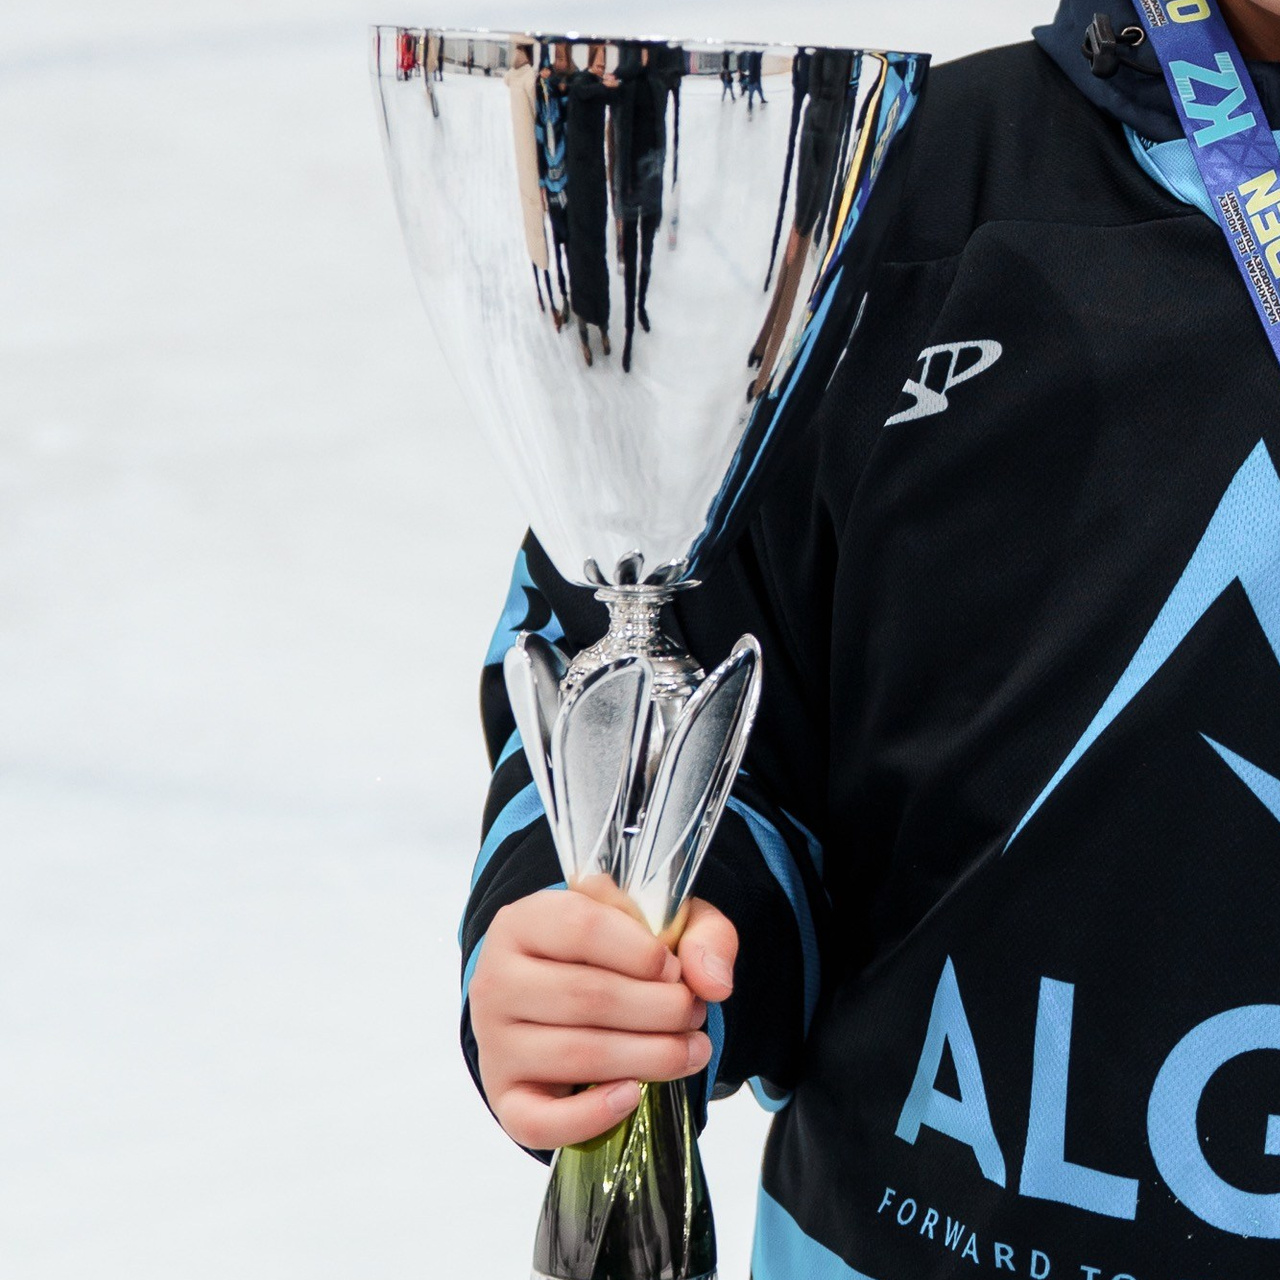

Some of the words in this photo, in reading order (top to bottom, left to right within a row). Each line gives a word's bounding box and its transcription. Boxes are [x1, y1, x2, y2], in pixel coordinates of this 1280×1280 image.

[1168, 51, 1257, 148] KZ
[1218, 195, 1239, 234] HOCKEY
[1226, 191, 1257, 252] TOURNAMENT
[1235, 238, 1249, 256] ICE
[1245, 260, 1278, 325] KAZAKHSTAN
